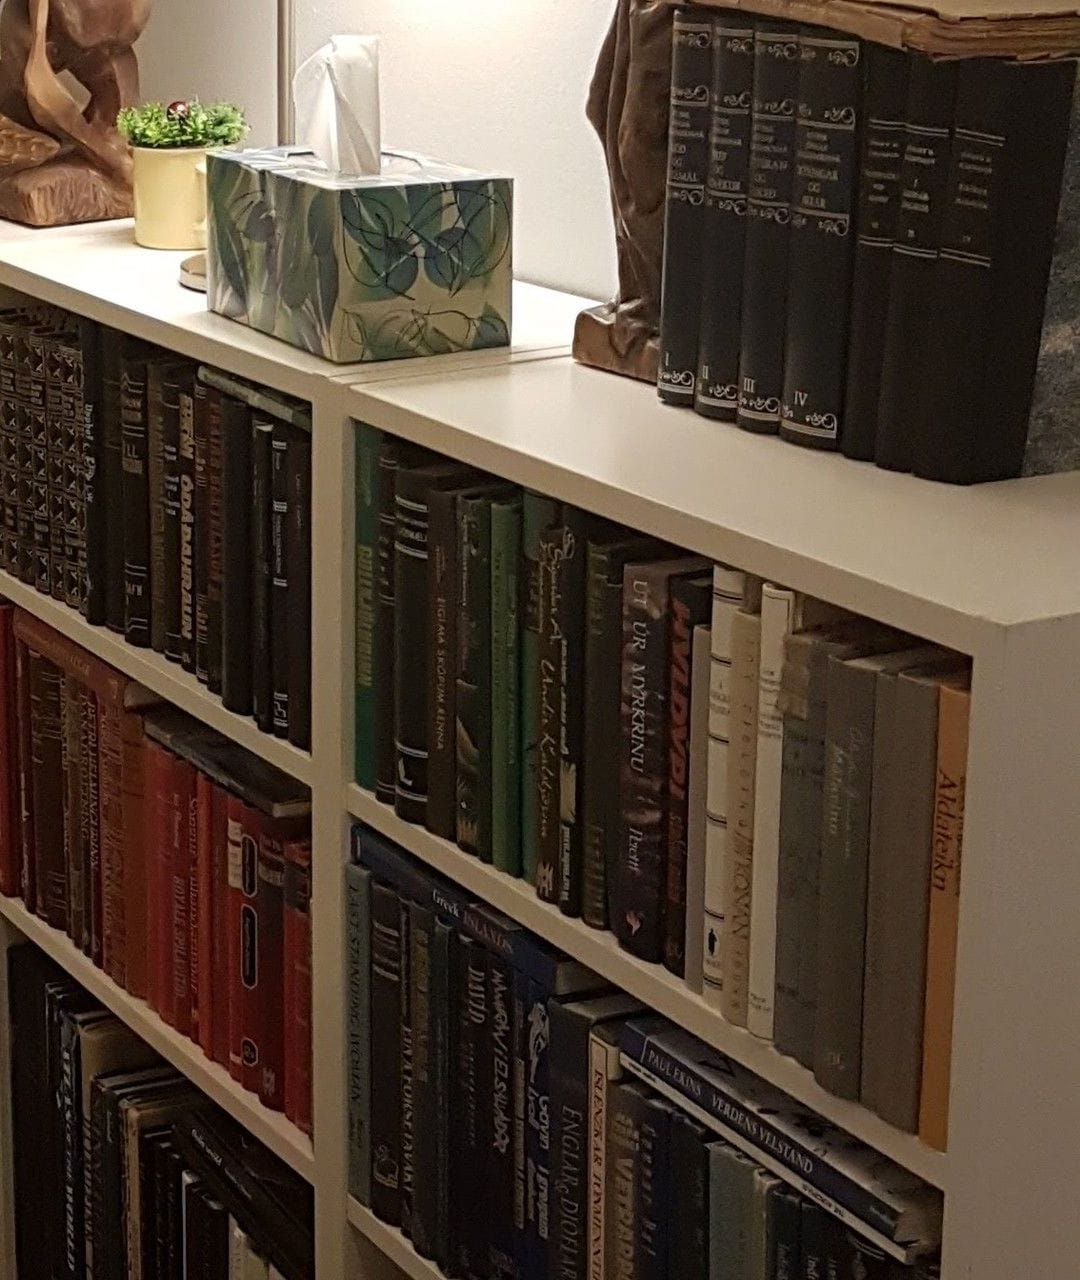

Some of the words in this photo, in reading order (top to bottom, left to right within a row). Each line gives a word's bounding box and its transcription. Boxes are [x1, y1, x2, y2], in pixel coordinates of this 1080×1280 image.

[743, 376, 757, 393] III
[793, 390, 809, 407] IV
[932, 768, 960, 893] Aldateikn
[349, 936, 361, 1025] STANDING
[350, 1032, 362, 1104] WOMAN
[537, 1095, 551, 1151] Gavin
[560, 1104, 583, 1186] ENGLAR
